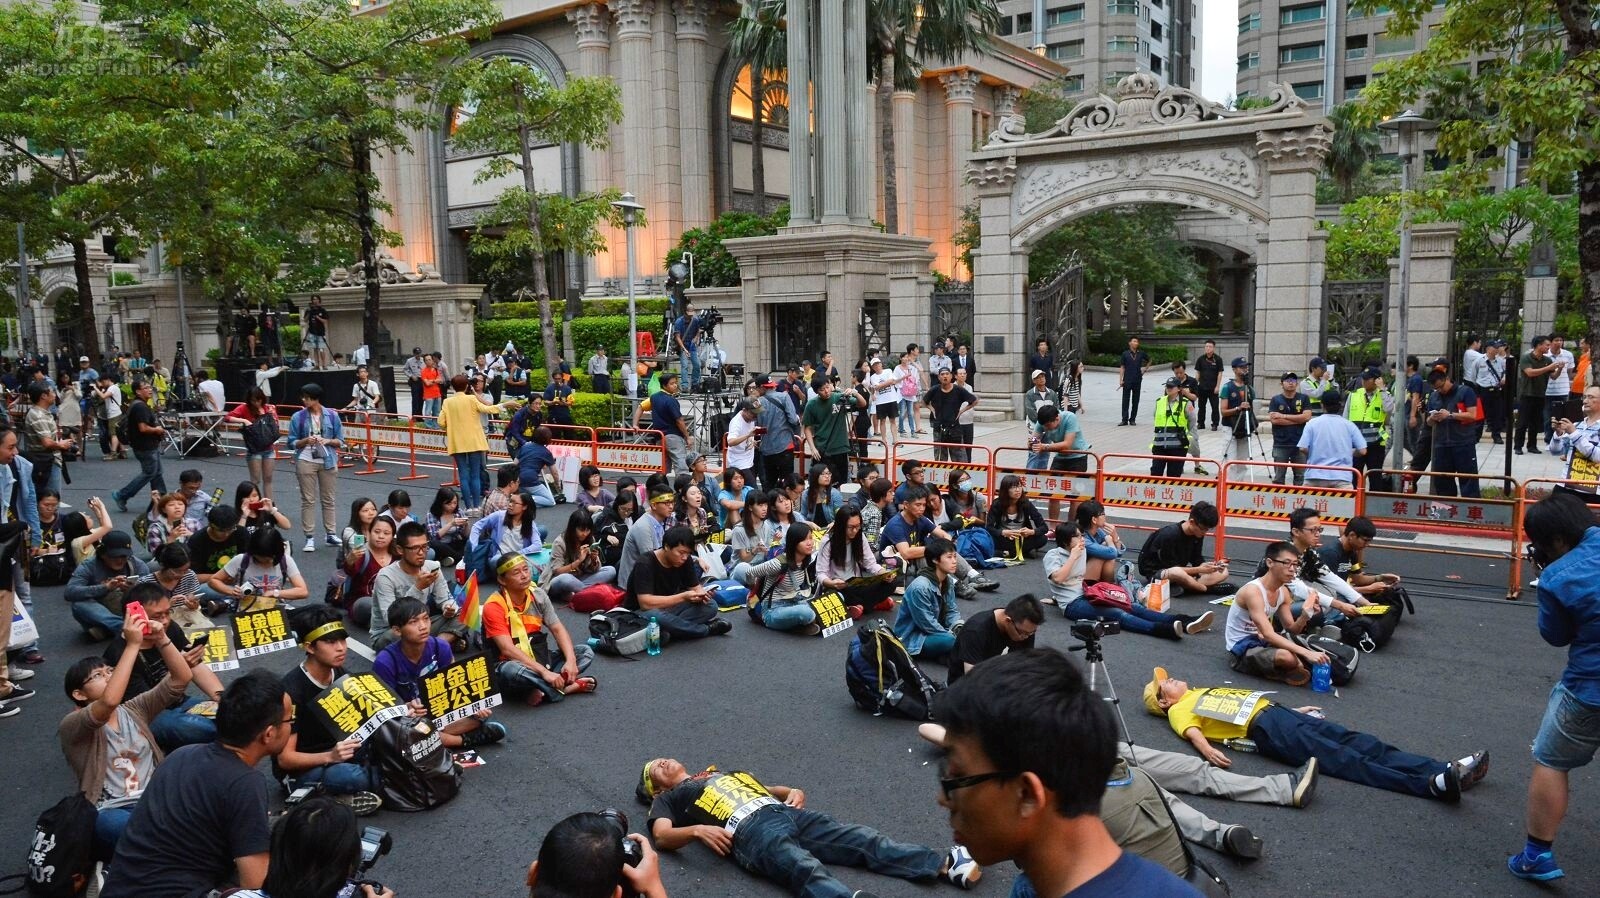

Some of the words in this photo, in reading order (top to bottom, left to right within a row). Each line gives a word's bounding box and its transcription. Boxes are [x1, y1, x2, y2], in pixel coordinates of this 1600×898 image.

[610, 451, 649, 464] 車輛改道
[1126, 484, 1193, 502] 車輛改道
[1253, 494, 1329, 513] 車輛改道
[239, 626, 287, 648] 爭公平
[425, 656, 489, 699] 滅金權
[317, 674, 387, 718] 滅金權
[333, 689, 397, 733] 爭公平
[429, 676, 492, 718] 爭公平
[434, 697, 494, 729] 給我住得起
